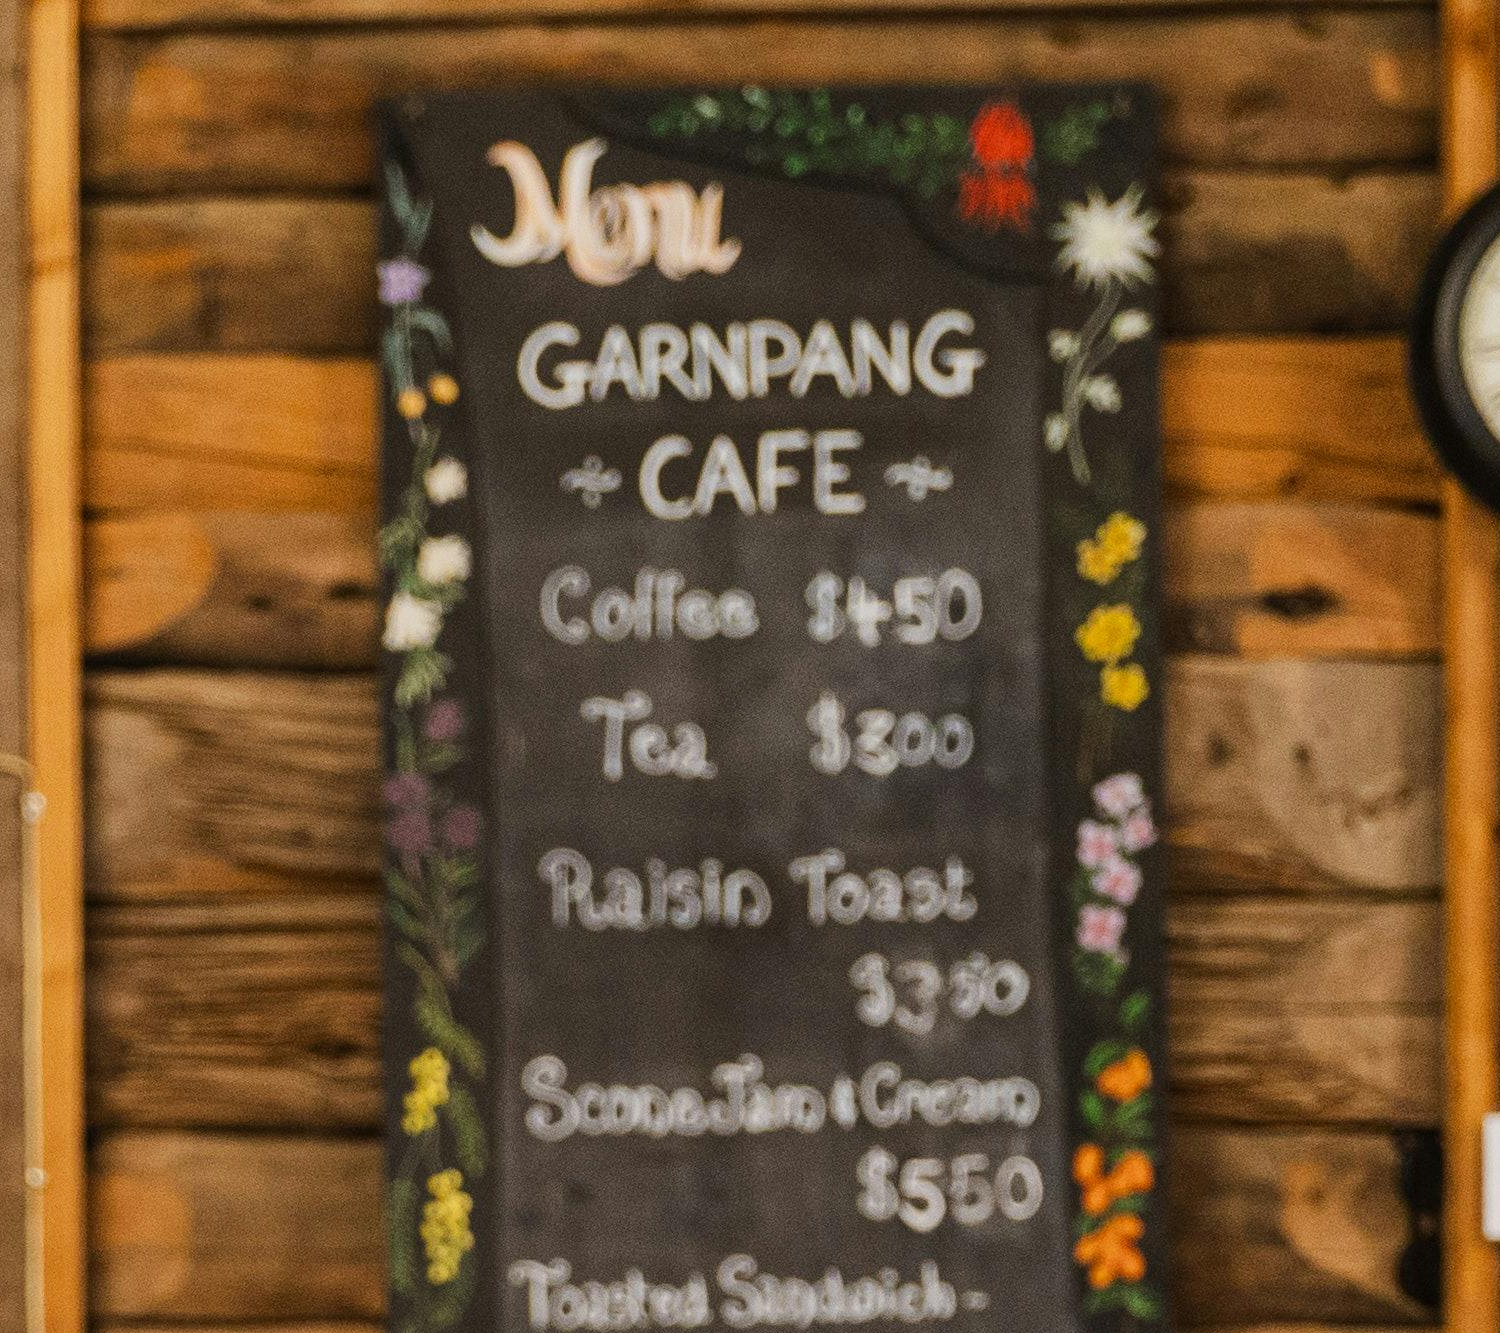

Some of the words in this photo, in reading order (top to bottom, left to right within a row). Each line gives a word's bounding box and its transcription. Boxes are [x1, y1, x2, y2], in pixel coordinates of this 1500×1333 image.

[470, 138, 742, 286] Menu
[517, 309, 985, 408] GARNPANG
[640, 430, 865, 519] CAFE
[540, 567, 759, 642] Coffee
[580, 689, 716, 780] Tea
[537, 848, 772, 931] Raisin
[788, 848, 978, 925] Toast
[861, 1061, 1041, 1128] Cream
[508, 1257, 712, 1331] Toasted
